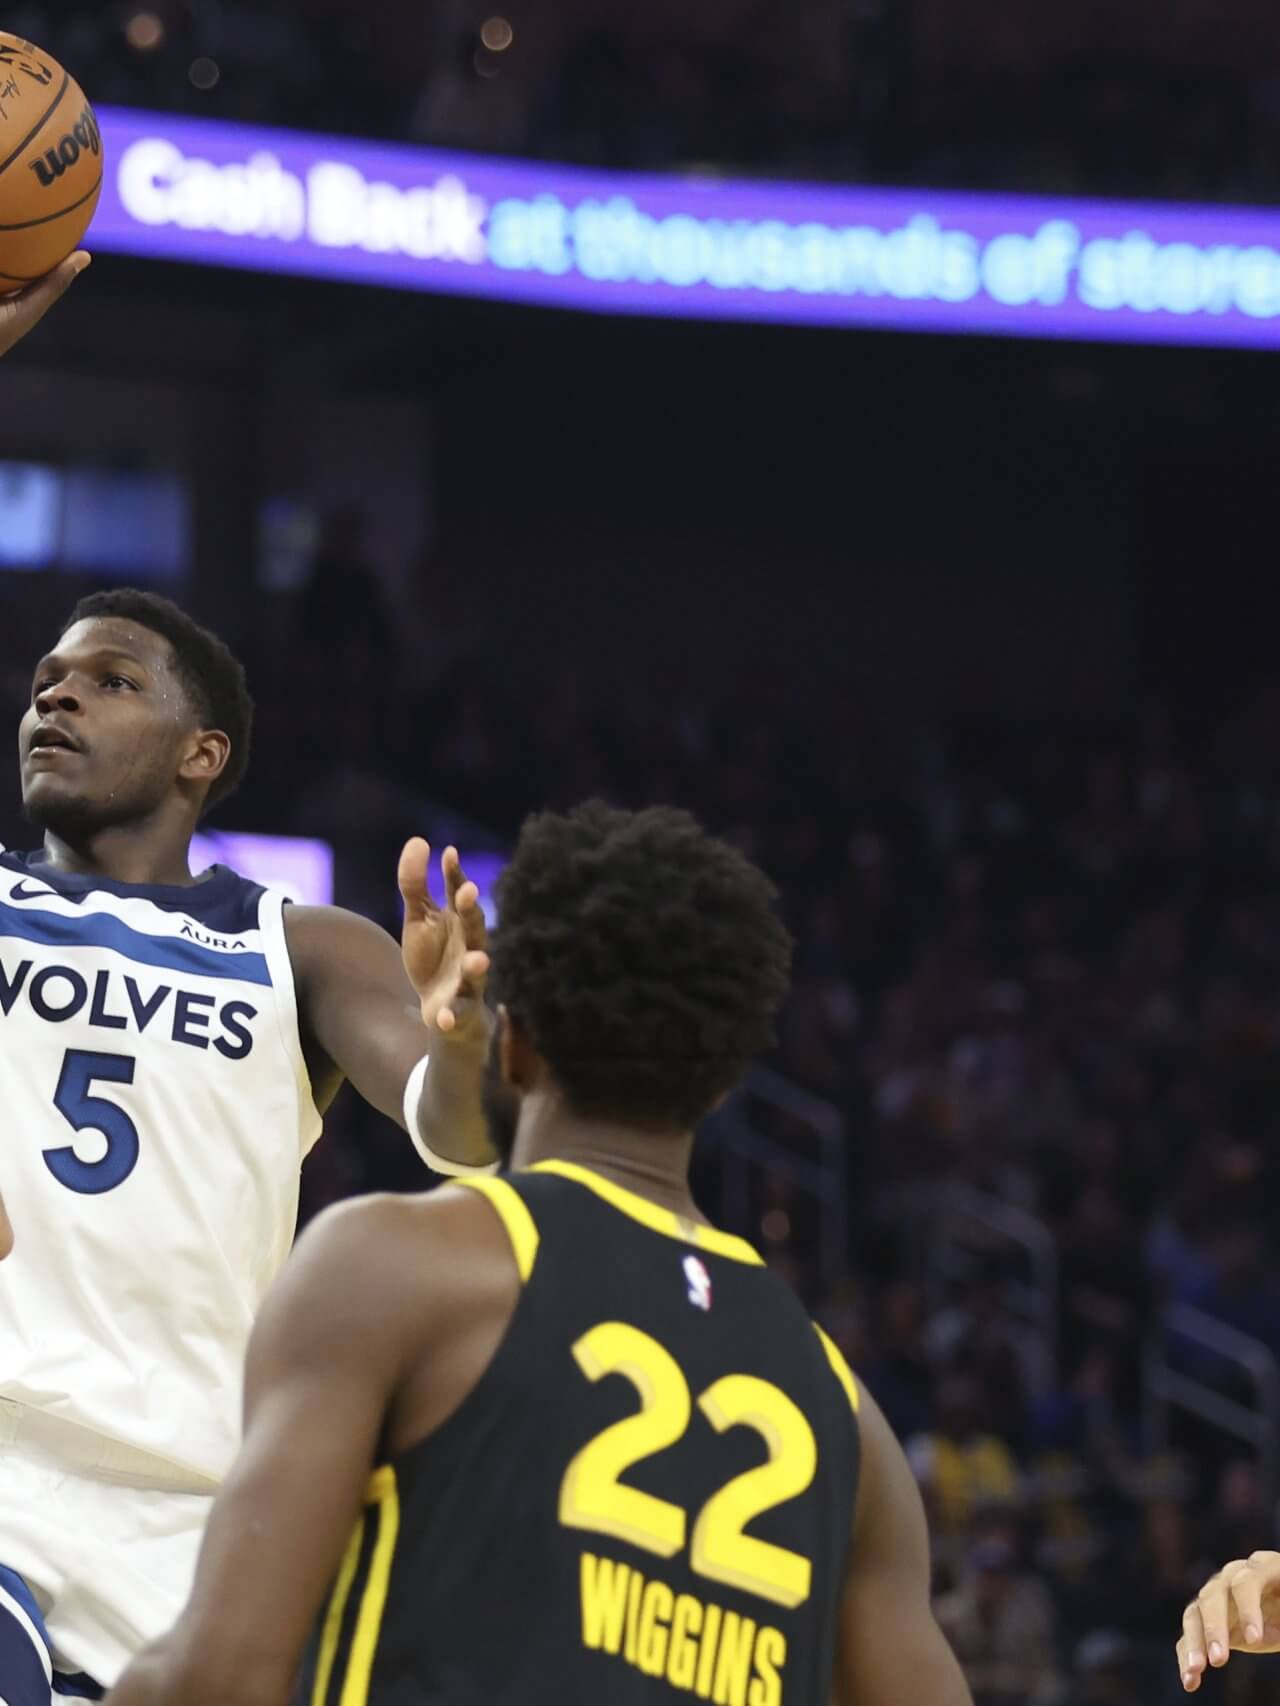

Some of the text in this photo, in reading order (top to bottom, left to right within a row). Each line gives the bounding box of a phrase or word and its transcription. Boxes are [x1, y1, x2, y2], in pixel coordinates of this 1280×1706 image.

[118, 138, 304, 242] Cash
[306, 160, 488, 264] Back
[488, 192, 572, 275] at
[573, 195, 979, 302] thousands
[981, 219, 1081, 306] of
[42, 1047, 140, 1195] 5
[558, 1321, 818, 1609] 22
[579, 1551, 787, 1706] WIGGINS
